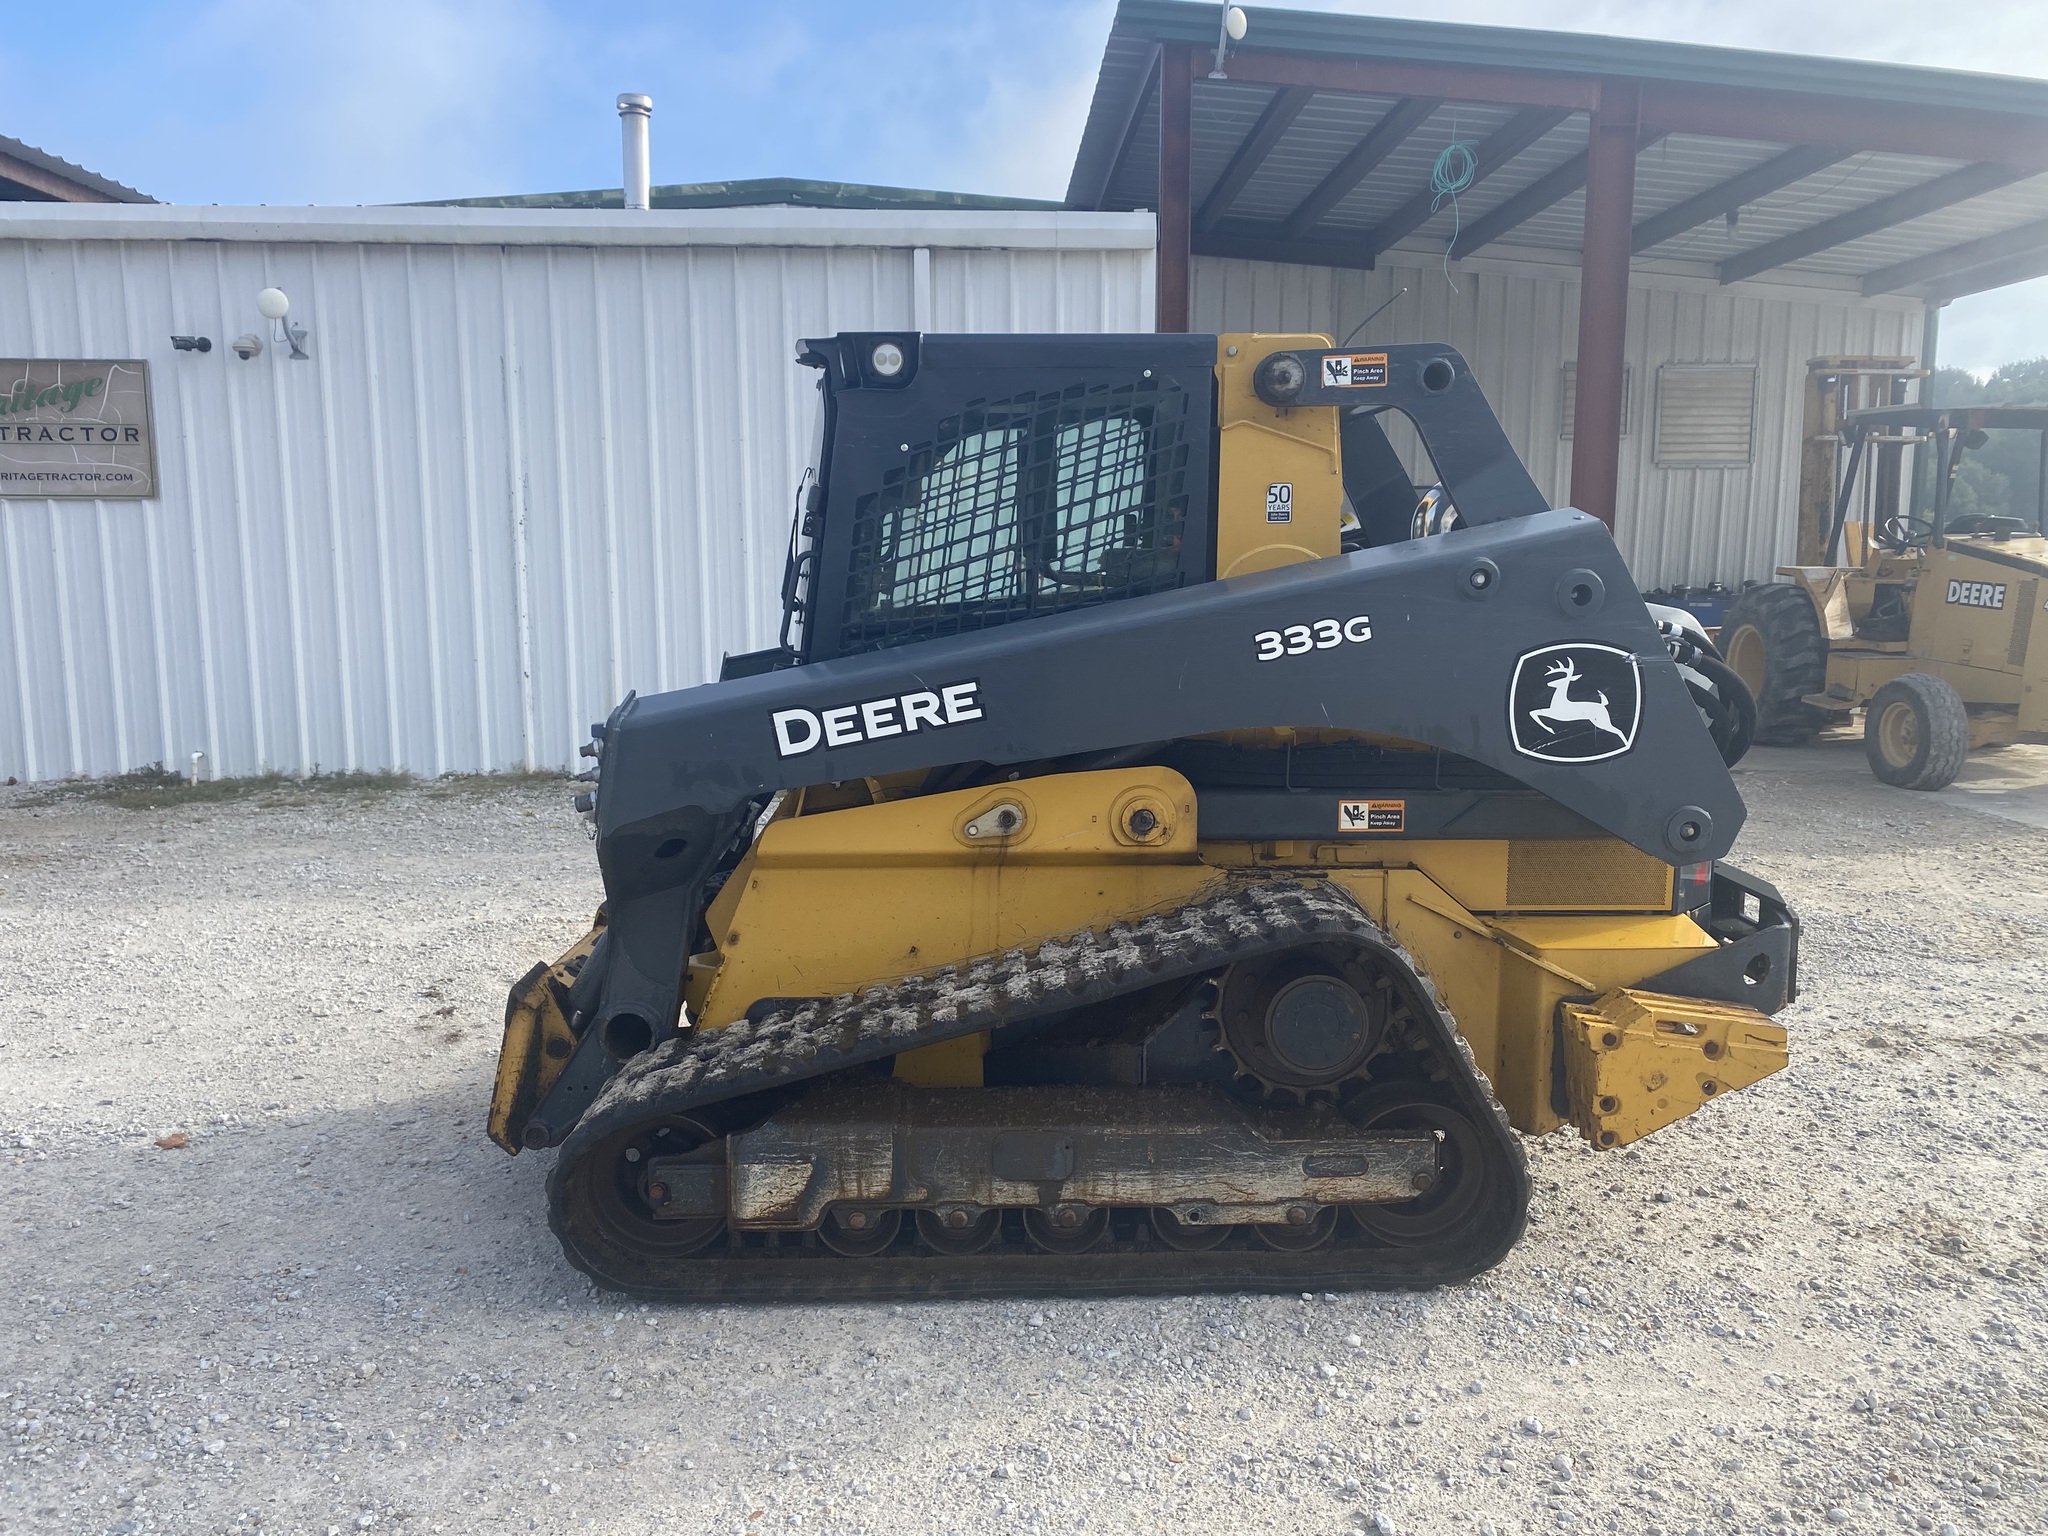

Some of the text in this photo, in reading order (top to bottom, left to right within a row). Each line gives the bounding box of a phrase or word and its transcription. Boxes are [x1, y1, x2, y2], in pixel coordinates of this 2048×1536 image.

[0, 426, 139, 442] TRACTOR
[0, 472, 133, 482] RITAGETRACTOR.COM
[1268, 485, 1290, 503] 50
[1947, 581, 2006, 608] DEERE
[1254, 615, 1372, 661] 333G
[771, 681, 983, 757] DEERE
